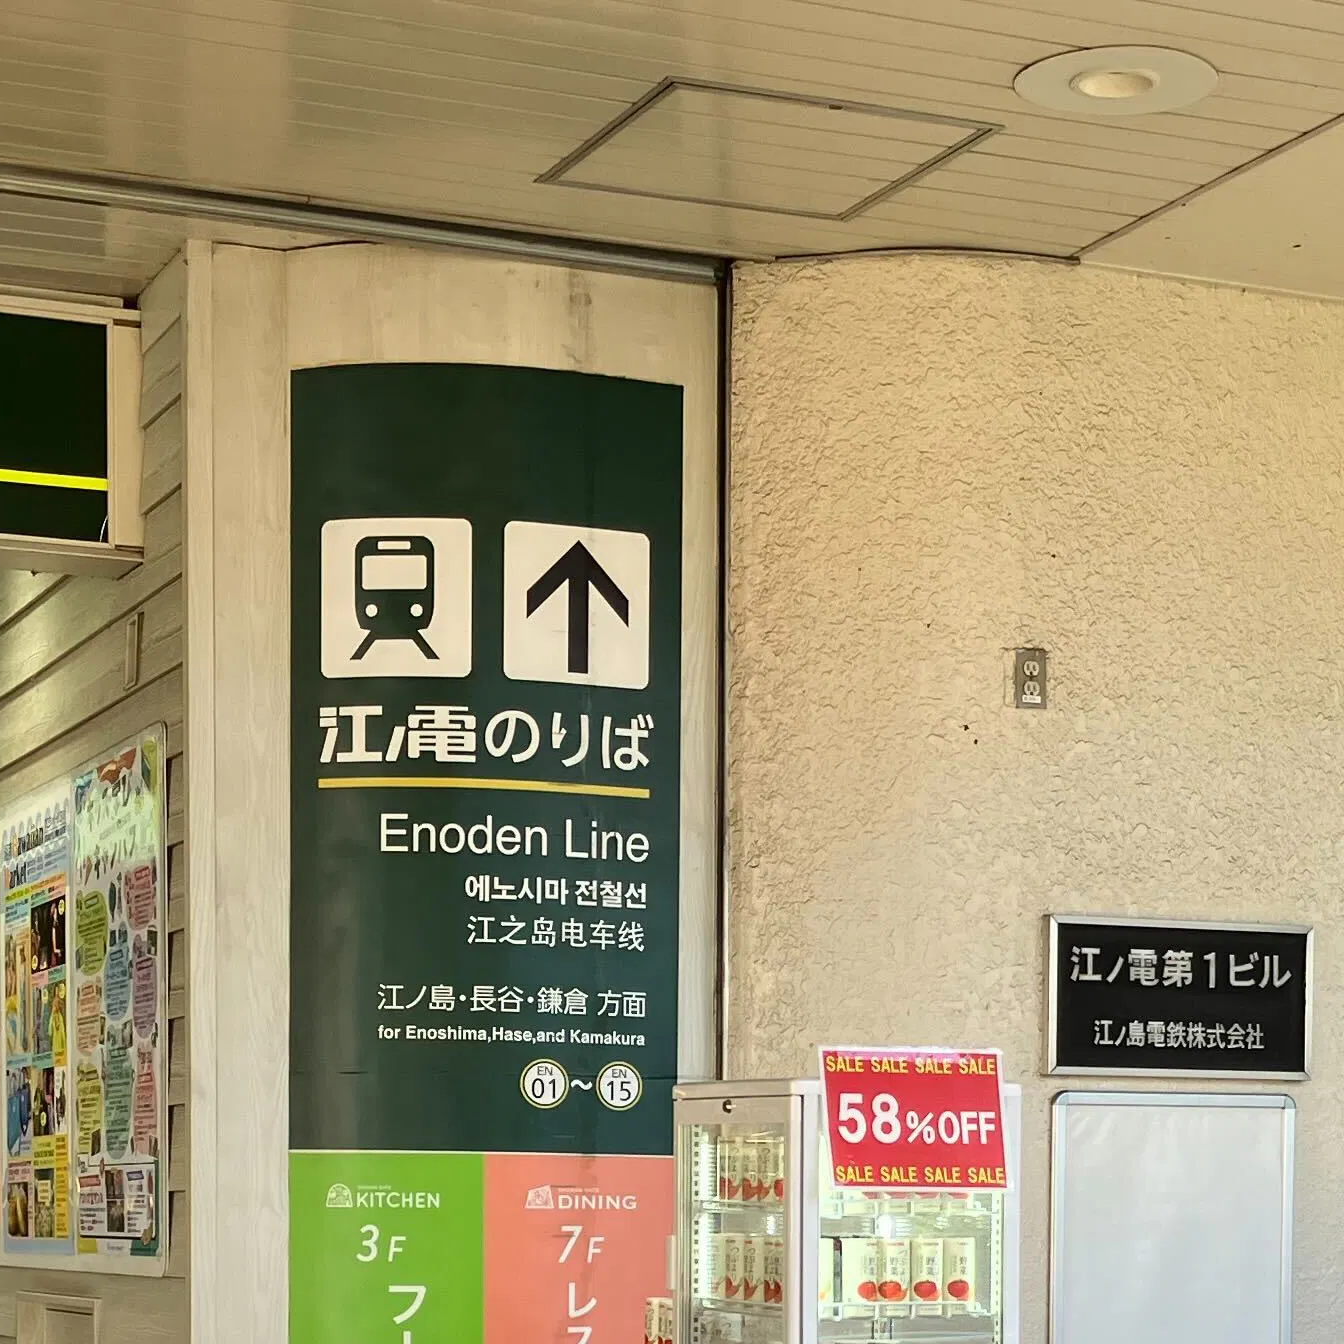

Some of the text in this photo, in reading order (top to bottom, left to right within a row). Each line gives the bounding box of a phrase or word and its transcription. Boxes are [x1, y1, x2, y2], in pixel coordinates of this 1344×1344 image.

[379, 811, 650, 864] Enoden Line
[464, 874, 647, 910] 에노시마 전철선
[466, 914, 645, 952] 江之岛电车线
[1069, 945, 1292, 989] 江ノ電第1ビル
[597, 989, 647, 1019] 方面
[377, 1023, 402, 1040] for
[569, 1028, 646, 1047] Kamakura
[1093, 1019, 1265, 1050] 江ノ島電鉄株式会社
[536, 1064, 554, 1077] EN
[611, 1068, 628, 1080] EN
[826, 1055, 997, 1075] SALE SALE SALE SALE
[530, 1078, 560, 1100] 01
[605, 1080, 632, 1102] 15
[837, 1092, 997, 1145] 58%OFF
[835, 1165, 1006, 1185] SALE SALE SALE SALE
[356, 1192, 441, 1209] KITCHEN
[558, 1194, 638, 1210] DINING
